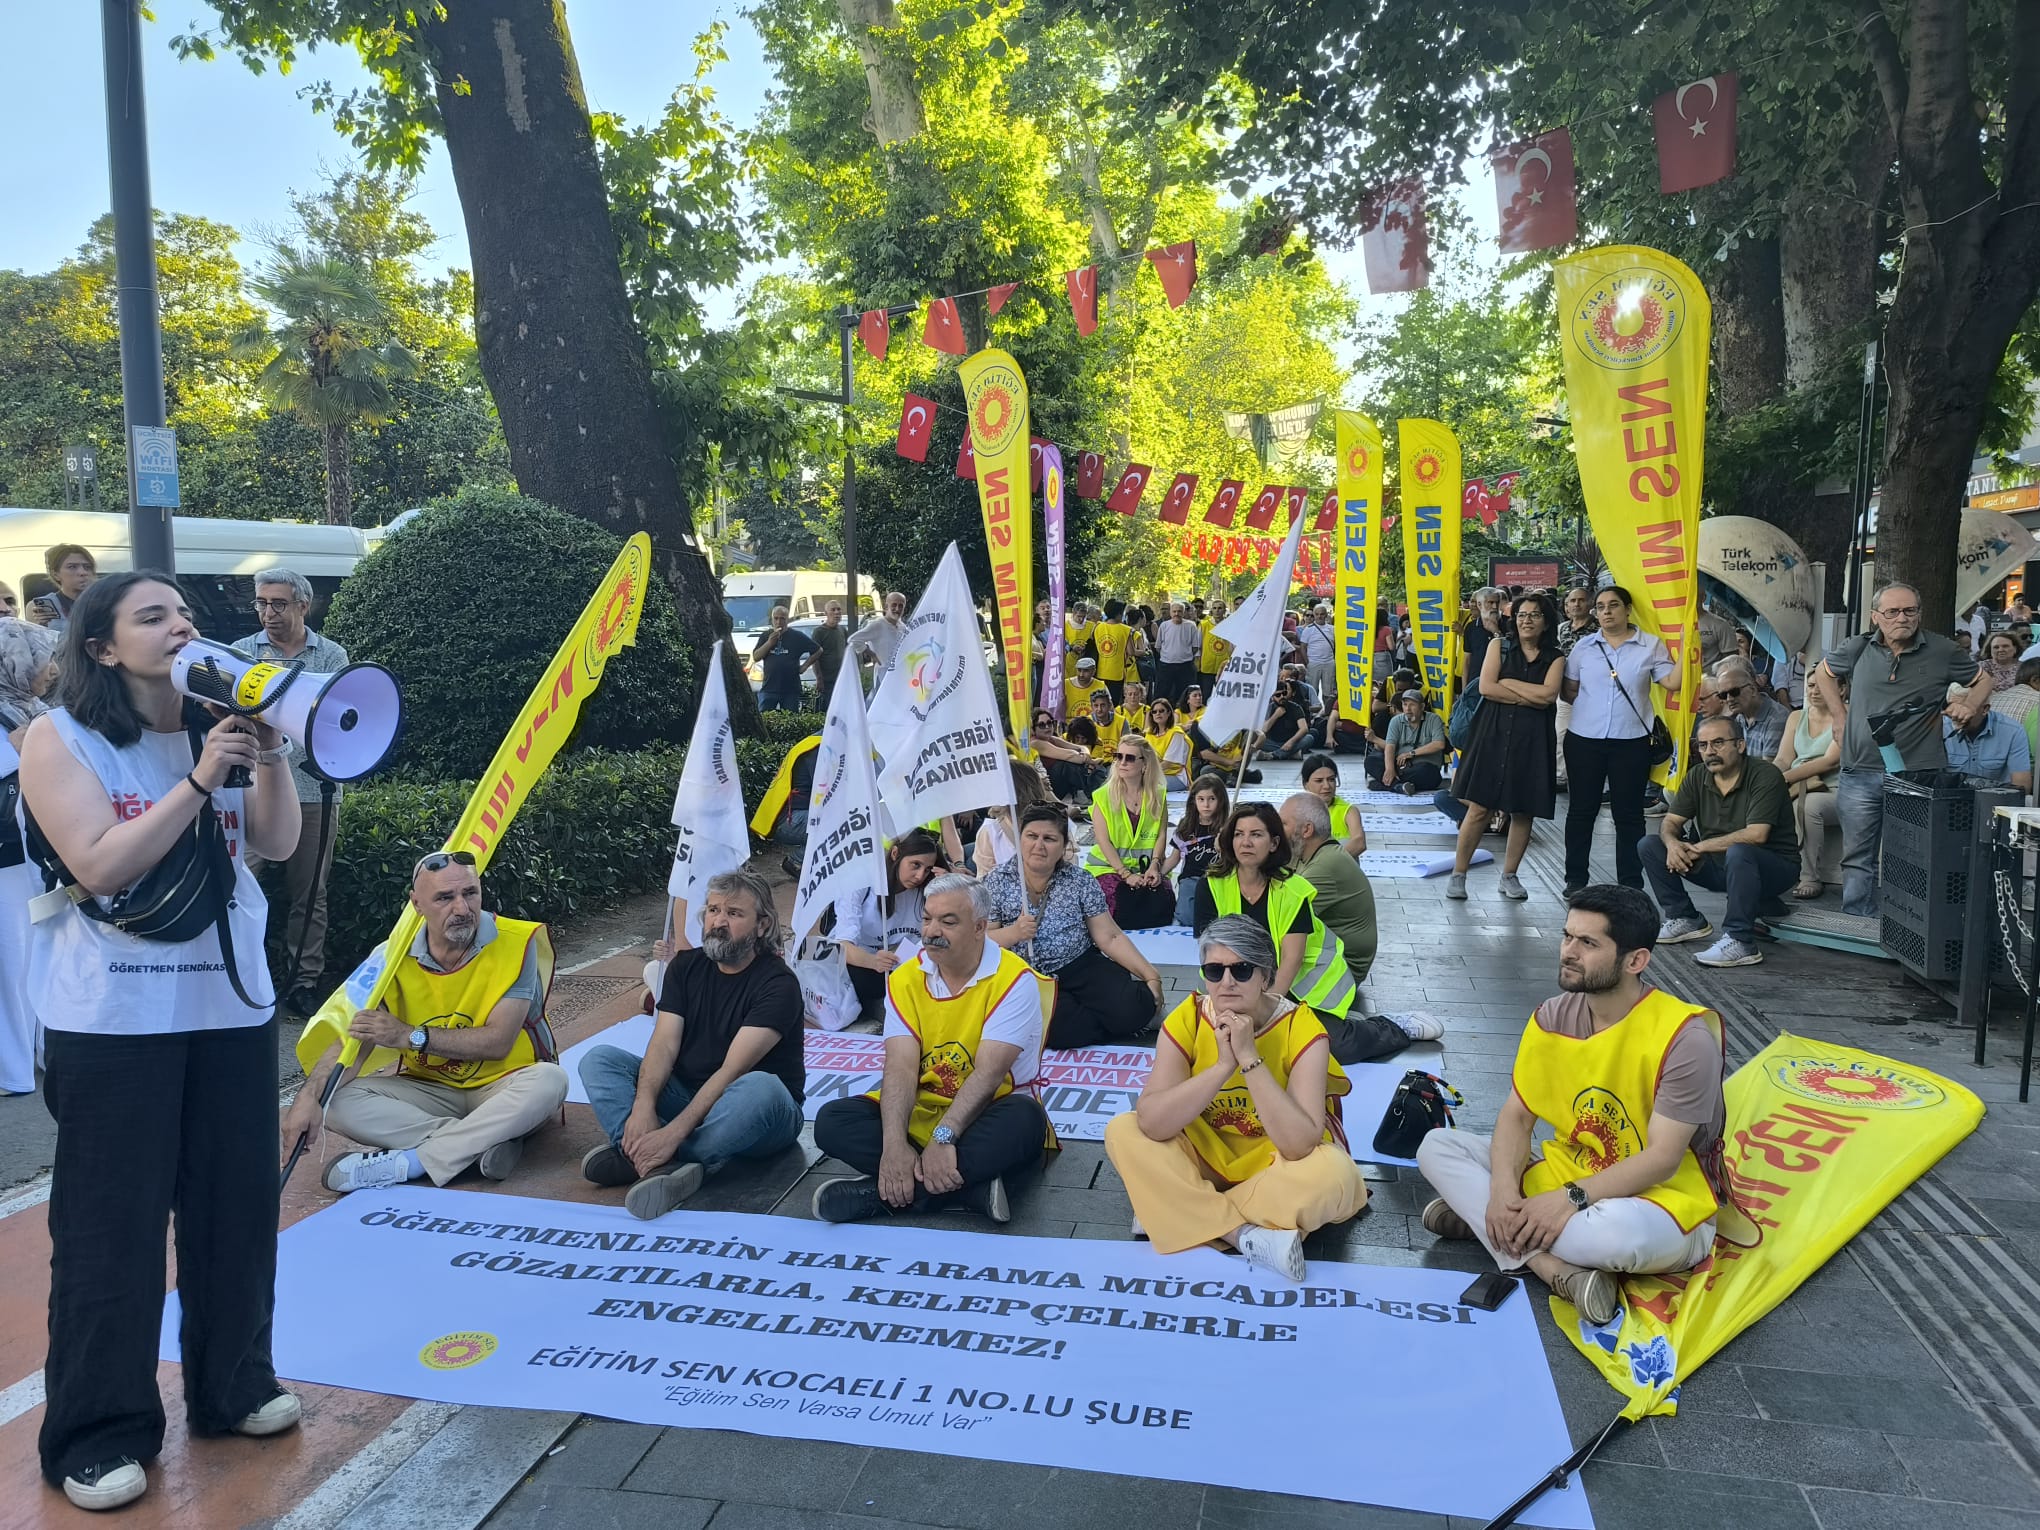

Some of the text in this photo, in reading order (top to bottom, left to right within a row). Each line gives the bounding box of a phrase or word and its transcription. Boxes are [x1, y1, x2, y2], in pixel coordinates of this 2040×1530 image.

[1721, 547, 1752, 559] Türk
[1721, 560, 1778, 572] Telekom
[108, 961, 226, 973] ÖĞRETMEN SENDİKAS
[1601, 1102, 1630, 1131] SEN
[359, 1206, 1477, 1325] ÖĞRETMENLERİN HAK ARAMA MÜCADELESİ
[450, 1250, 1298, 1342] GÖZALTILARLA, KELEPÇELERLE
[587, 1298, 1067, 1360] ENGELLENEMEZ!
[526, 1345, 1194, 1430] EĞİTİM SEN KOCAELİ 1 NO.LU ŞUBE
[741, 1393, 791, 1410] Sen
[797, 1397, 862, 1419] Varsa
[868, 1405, 936, 1427] Umut
